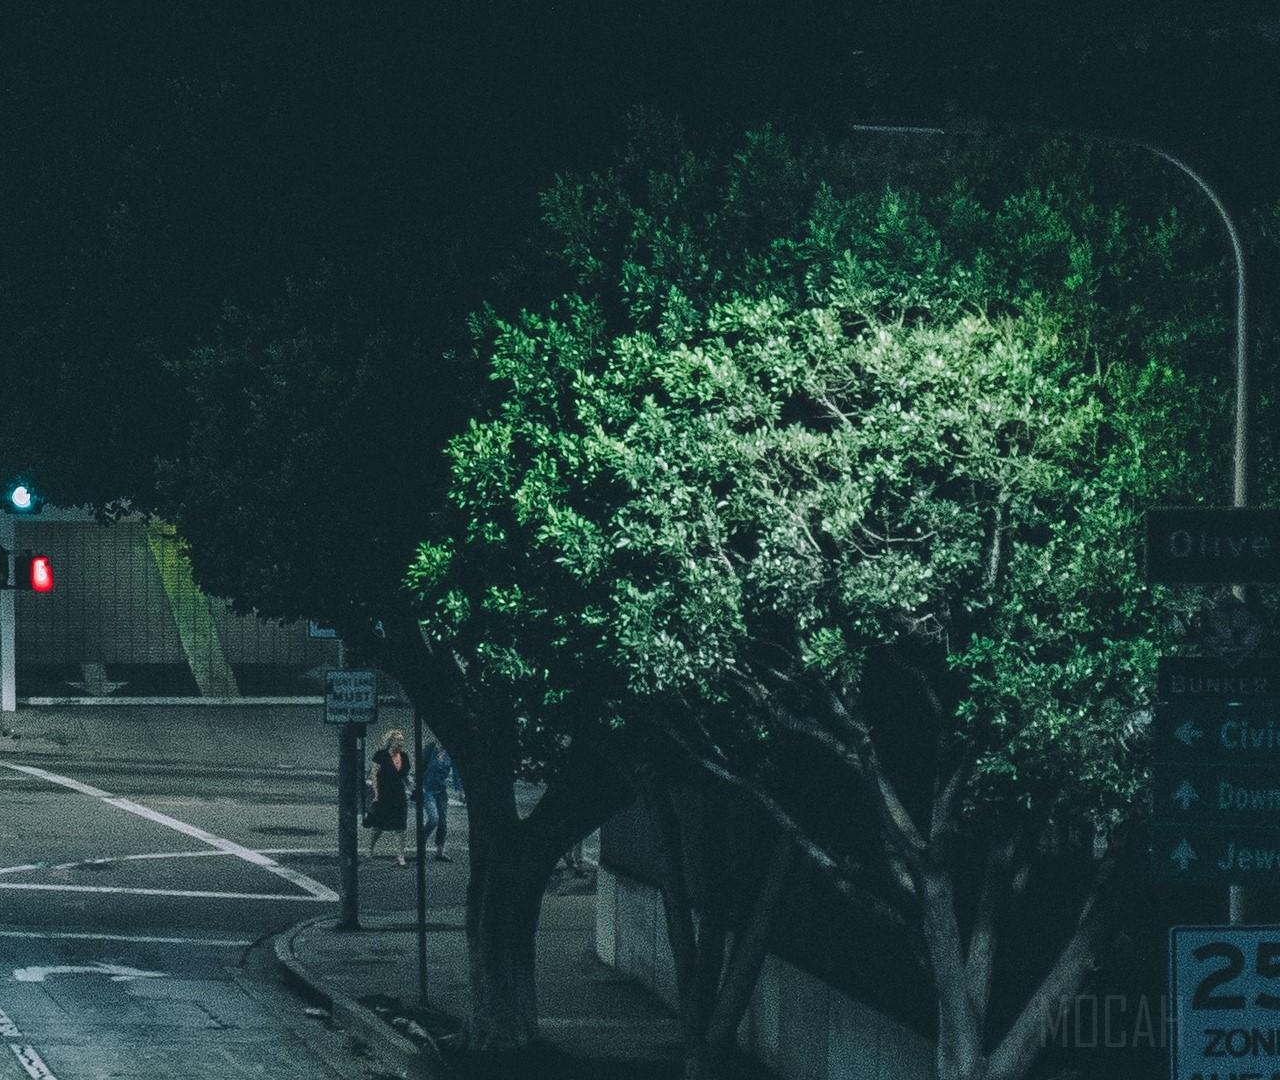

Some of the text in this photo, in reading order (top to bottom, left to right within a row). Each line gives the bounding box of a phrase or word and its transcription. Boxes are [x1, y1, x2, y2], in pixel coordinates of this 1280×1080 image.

[1170, 529, 1272, 559] Olive
[1171, 674, 1268, 694] BUNKER
[1220, 719, 1280, 749] Civi
[1217, 840, 1280, 871] Jew
[1203, 1028, 1280, 1058] ZON
